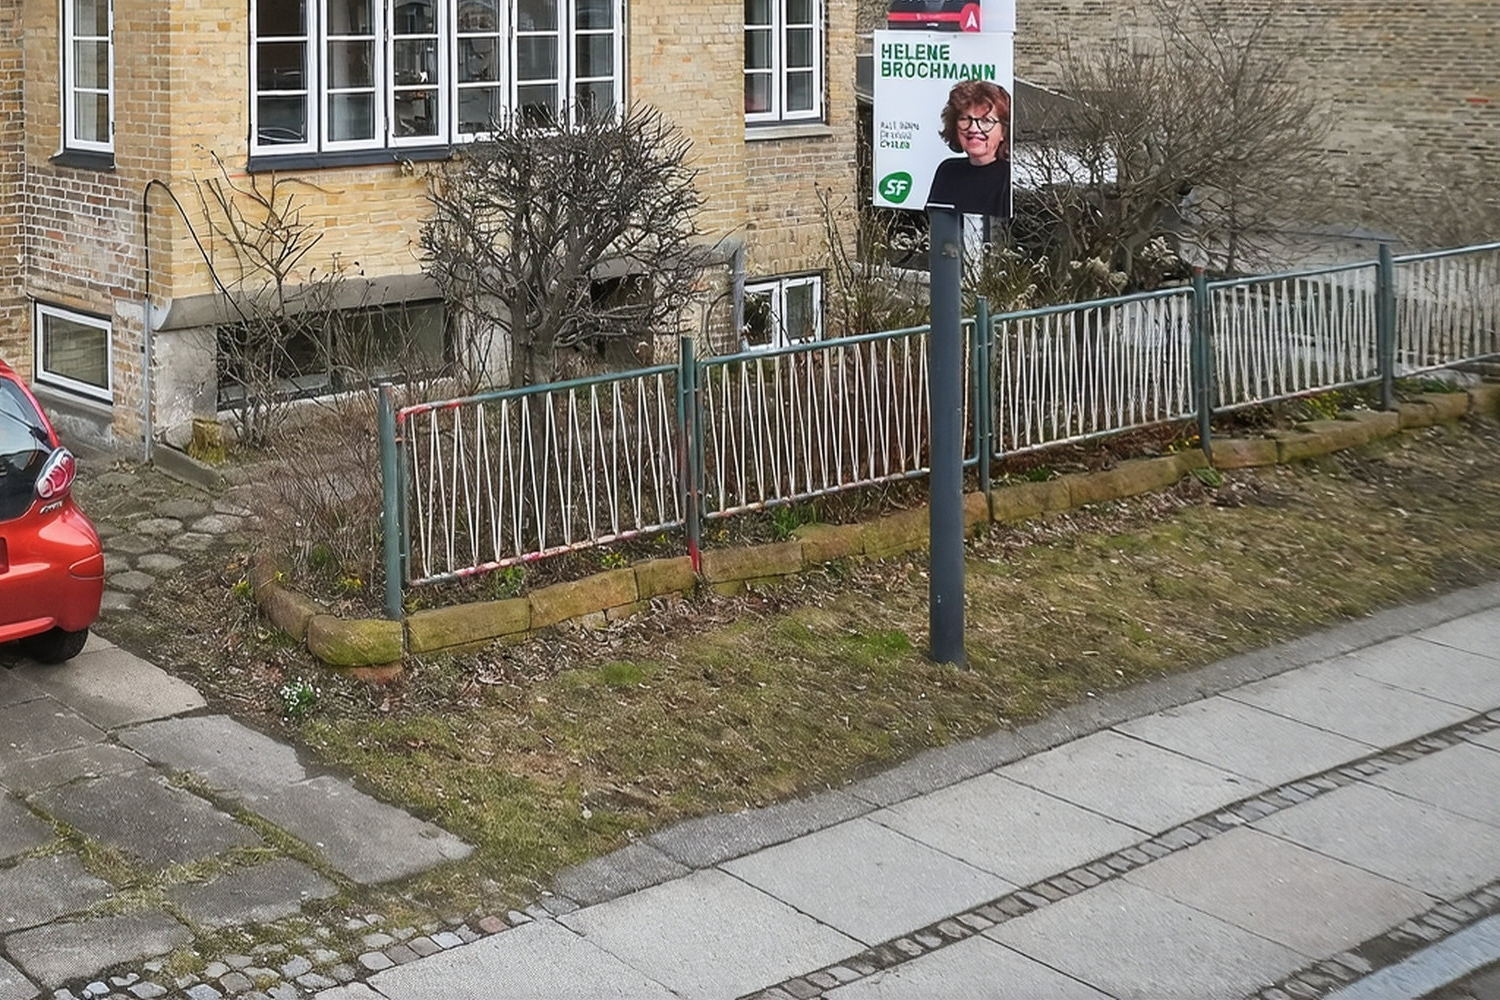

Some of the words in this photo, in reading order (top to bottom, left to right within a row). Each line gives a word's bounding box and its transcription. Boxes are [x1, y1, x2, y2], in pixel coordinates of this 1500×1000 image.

[881, 43, 950, 61] HELENE
[881, 61, 996, 81] BROCHMANN
[884, 179, 908, 196] SF
